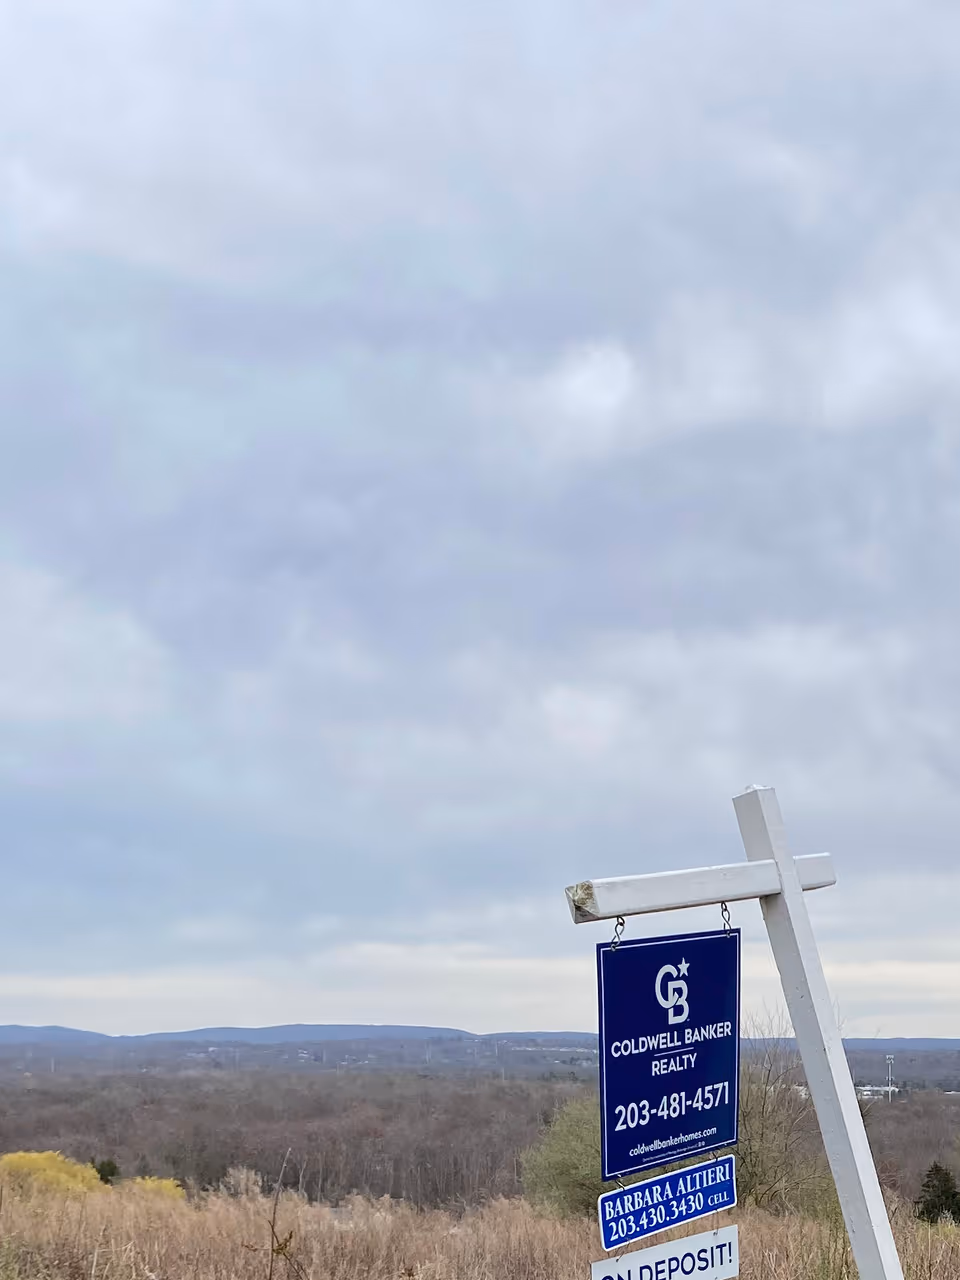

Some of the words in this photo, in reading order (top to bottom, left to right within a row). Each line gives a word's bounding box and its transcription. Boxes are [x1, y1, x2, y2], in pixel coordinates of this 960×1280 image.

[611, 1031, 681, 1057] COLDWELL
[685, 1021, 732, 1042] BANKER
[652, 1053, 697, 1076] REALTY
[614, 1081, 729, 1131] 203-481-4571
[629, 1126, 717, 1156] coldwellbankerhomes.com
[604, 1181, 673, 1220] BARBARA
[676, 1163, 730, 1197] ALTIERI
[609, 1192, 704, 1241] 203.430.3430
[708, 1191, 729, 1206] CELL
